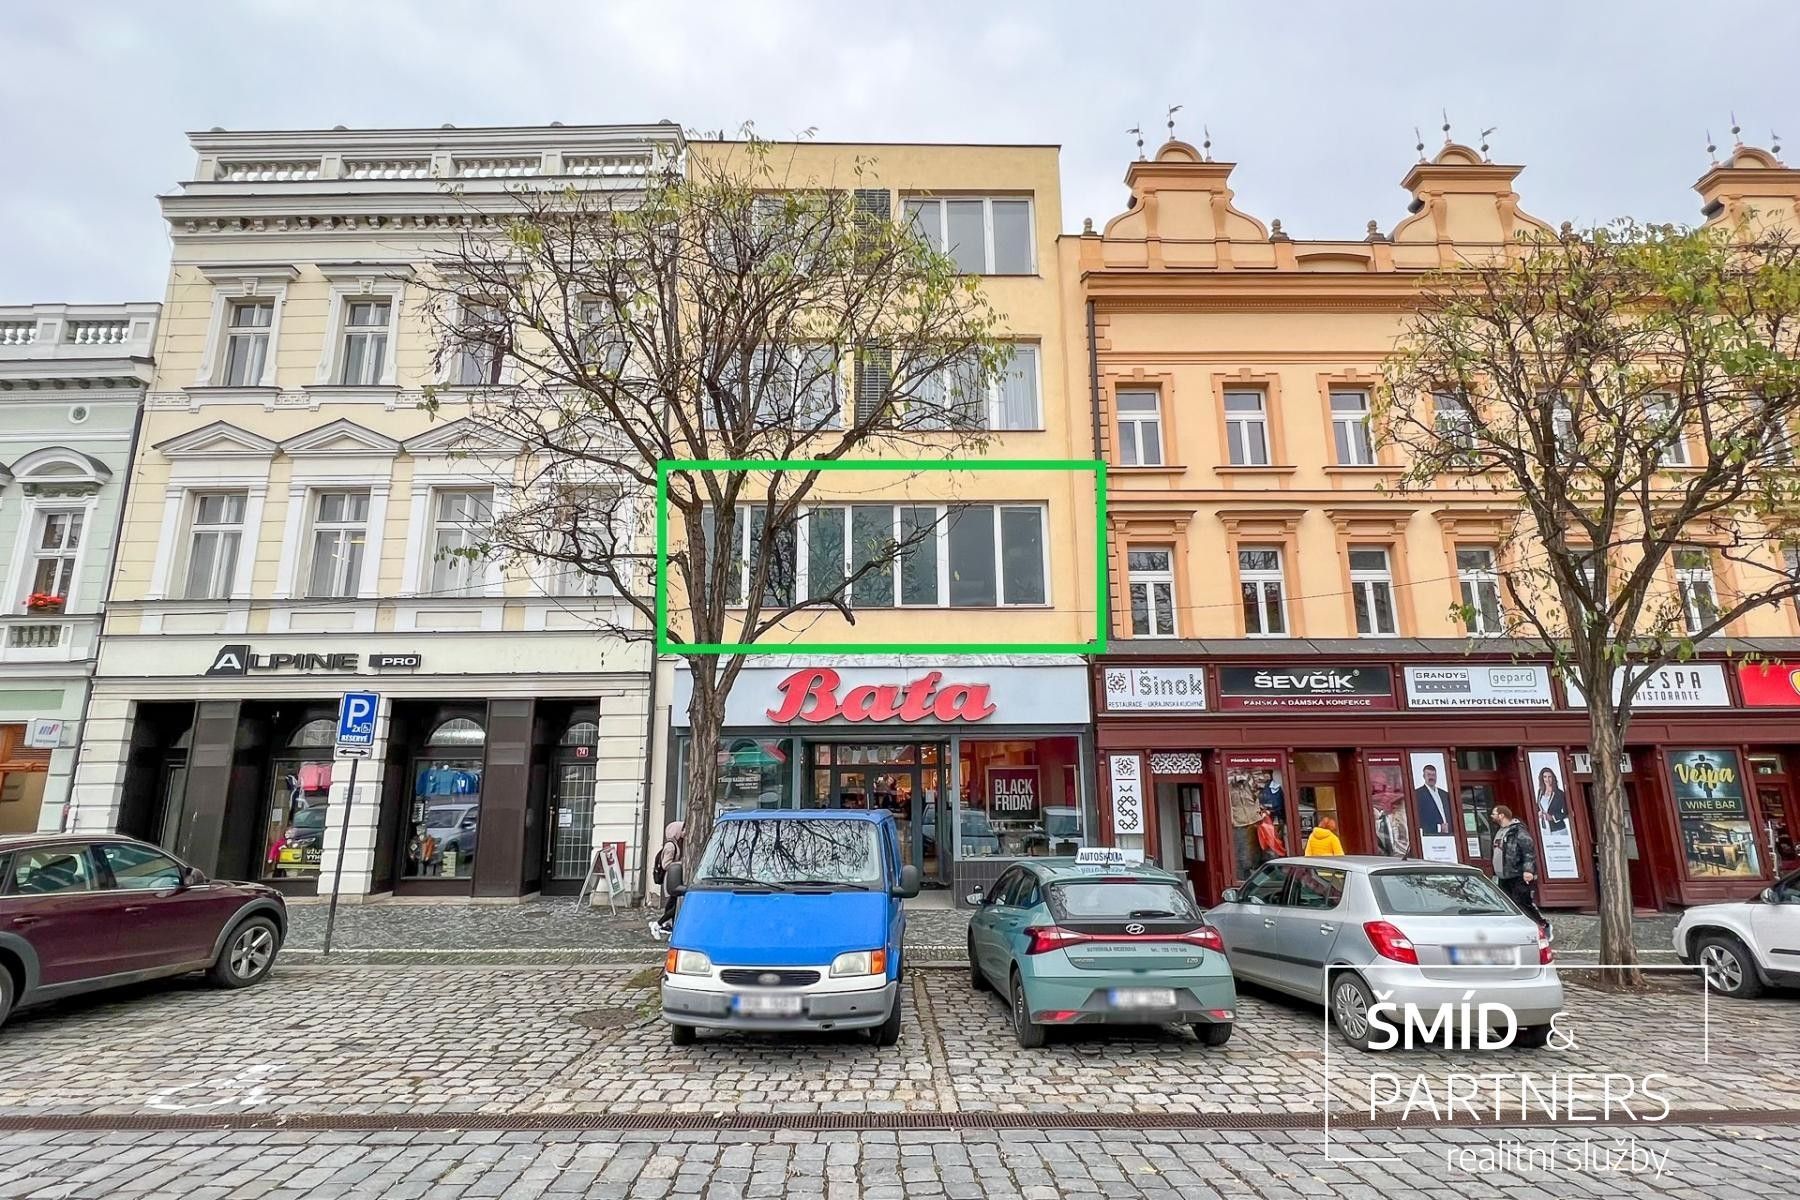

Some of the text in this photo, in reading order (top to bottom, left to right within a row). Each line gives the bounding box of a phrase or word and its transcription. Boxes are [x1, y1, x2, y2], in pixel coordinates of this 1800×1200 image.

[209, 648, 418, 673] ALPINE PRO
[1139, 670, 1203, 695] Šinok
[1254, 670, 1355, 689] ŠEVČÍK
[1492, 671, 1533, 684] gepard
[1411, 697, 1449, 705] REALITNÍ
[1460, 697, 1507, 705] HYPOTEČNÍ
[346, 698, 370, 729] P
[351, 724, 361, 733] 2x
[1674, 763, 1735, 790] Vespa
[994, 778, 1033, 795] BLACK
[995, 794, 1034, 811] FRIDAY
[1686, 800, 1736, 809] WINE BAR
